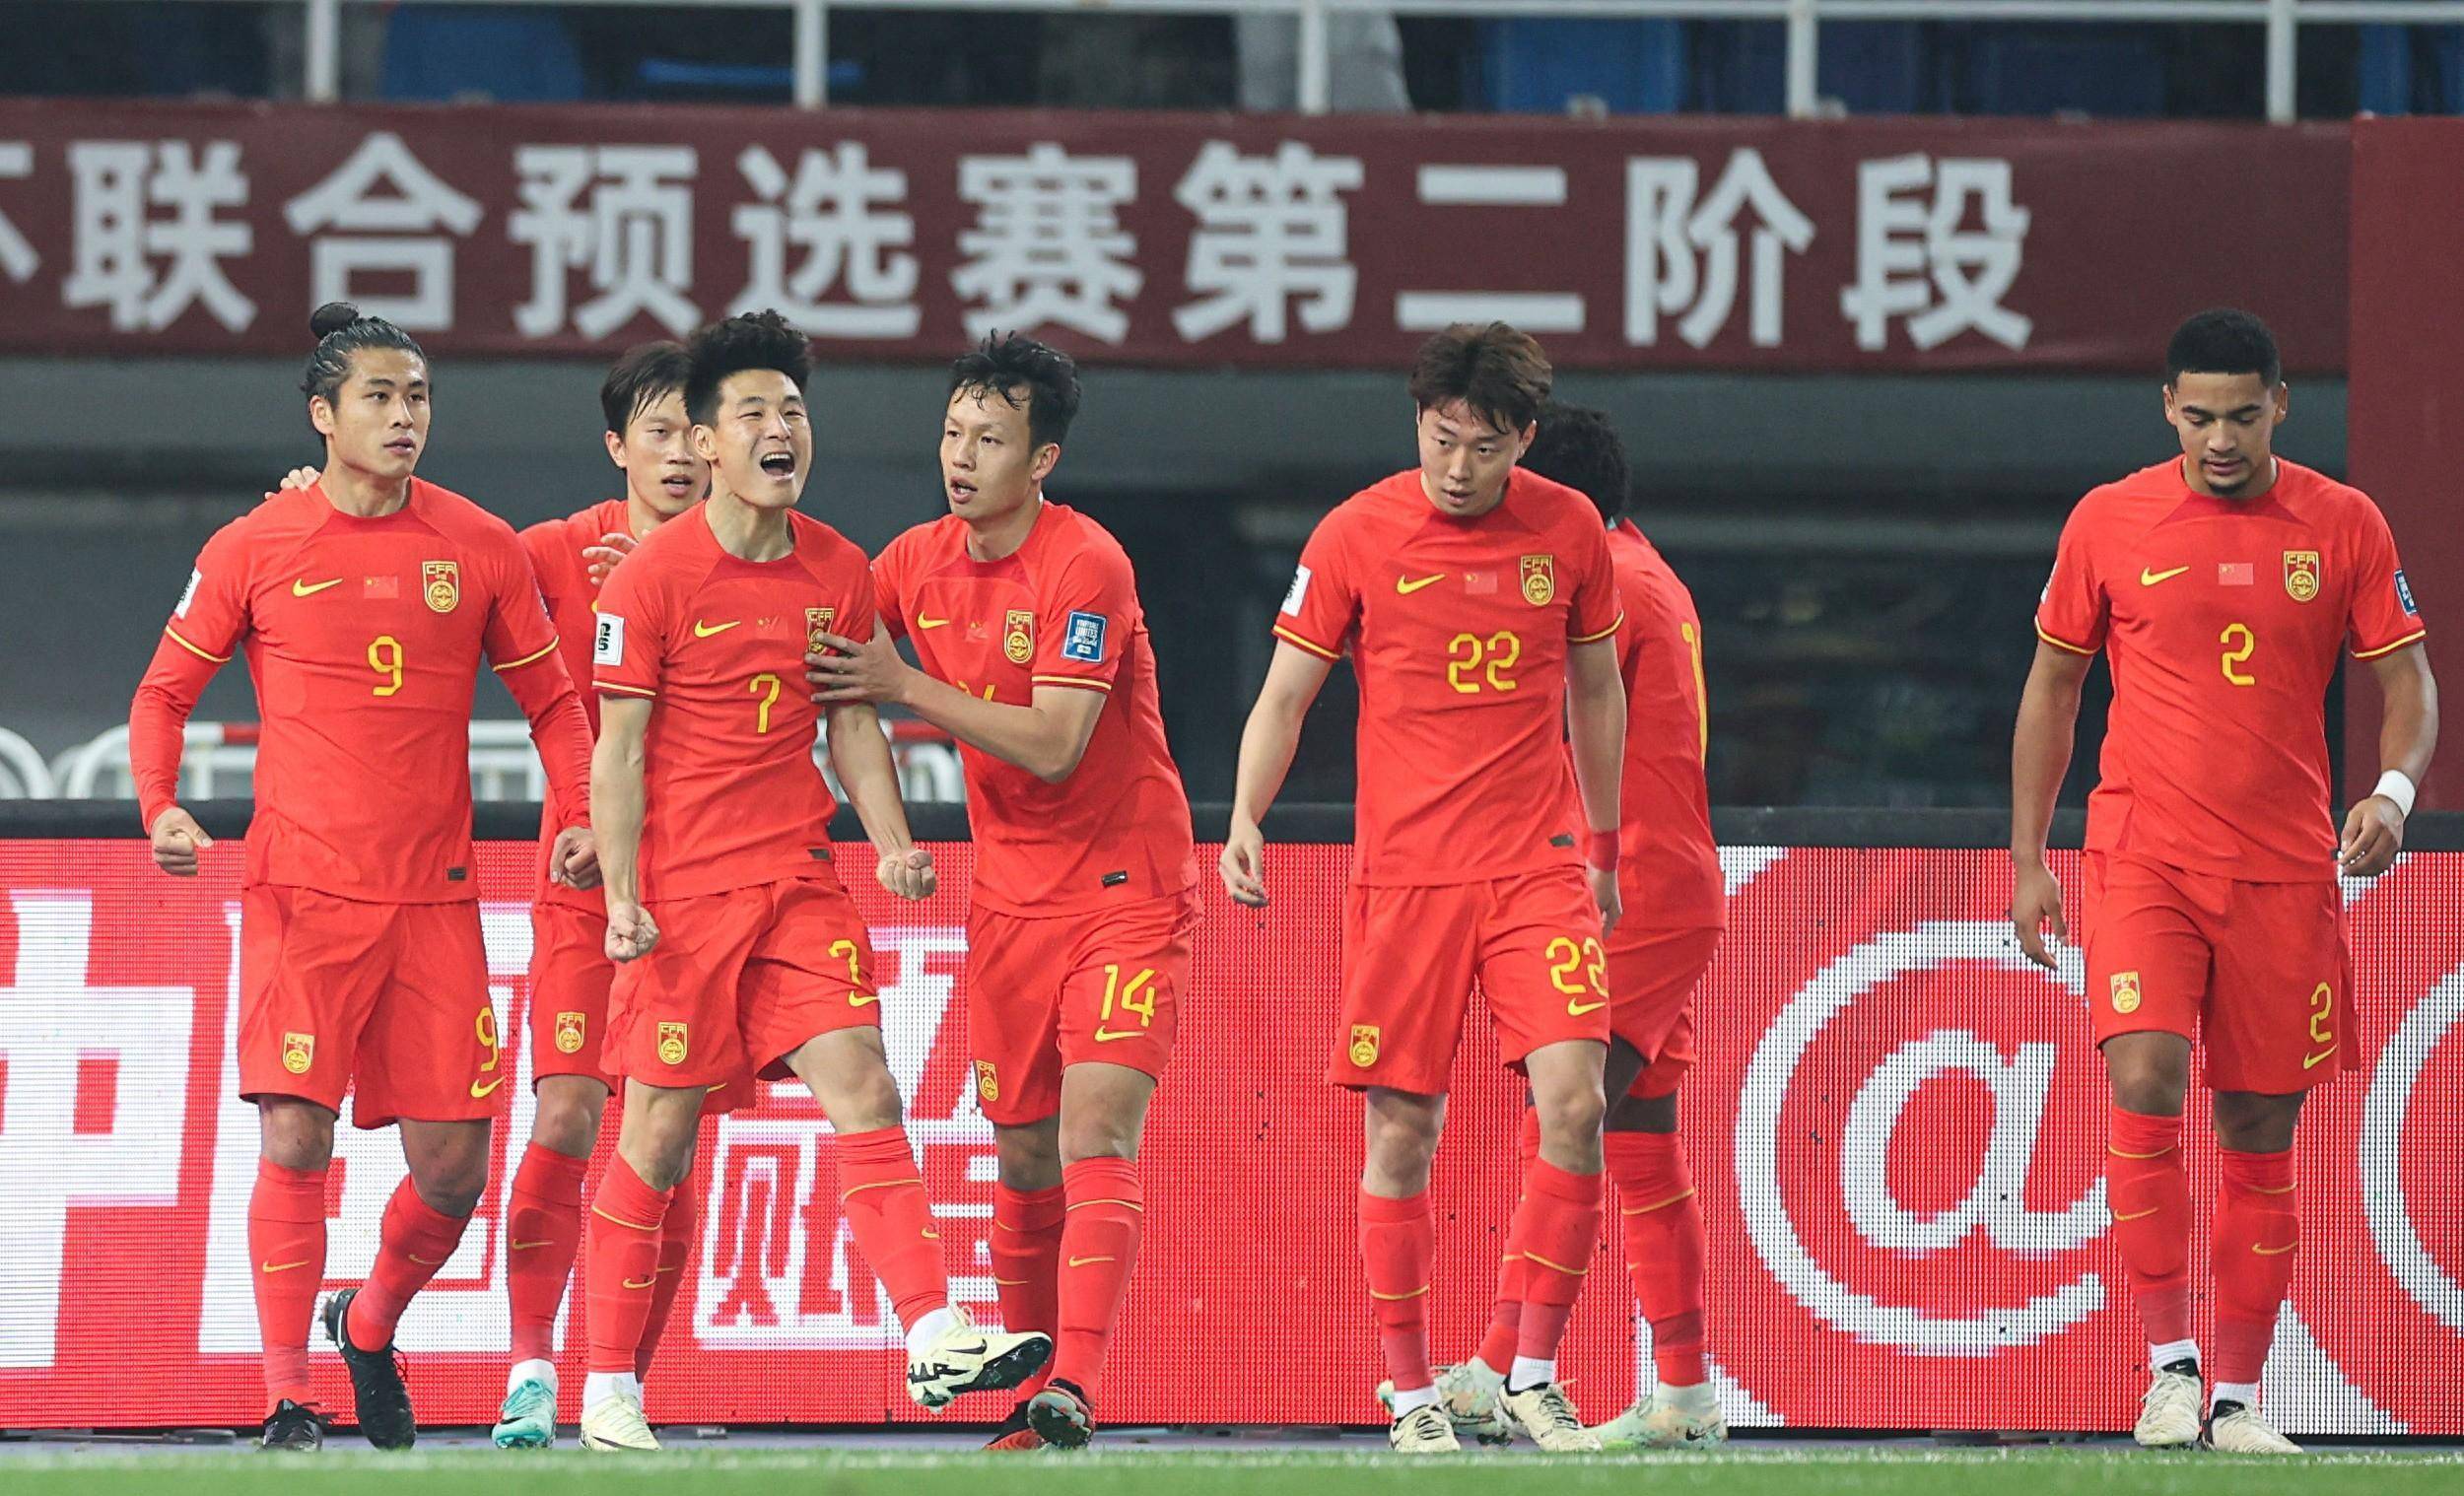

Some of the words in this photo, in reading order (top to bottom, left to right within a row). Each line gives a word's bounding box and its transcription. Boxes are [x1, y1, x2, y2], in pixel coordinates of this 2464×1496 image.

[0, 134, 2032, 351] 联合预选赛第二阶段
[426, 564, 455, 575] CFA
[1524, 559, 1549, 569] CFA
[2287, 554, 2315, 565] CFA
[1009, 615, 1031, 625] CFA
[368, 635, 403, 697] 9
[1447, 631, 1521, 694] 22
[2220, 623, 2256, 686] 2
[749, 673, 782, 734] 7
[828, 939, 861, 986] 7
[1544, 936, 1609, 999] 22
[1100, 964, 1156, 1028] 14
[2309, 982, 2333, 1043] 2
[475, 1006, 499, 1072] 9
